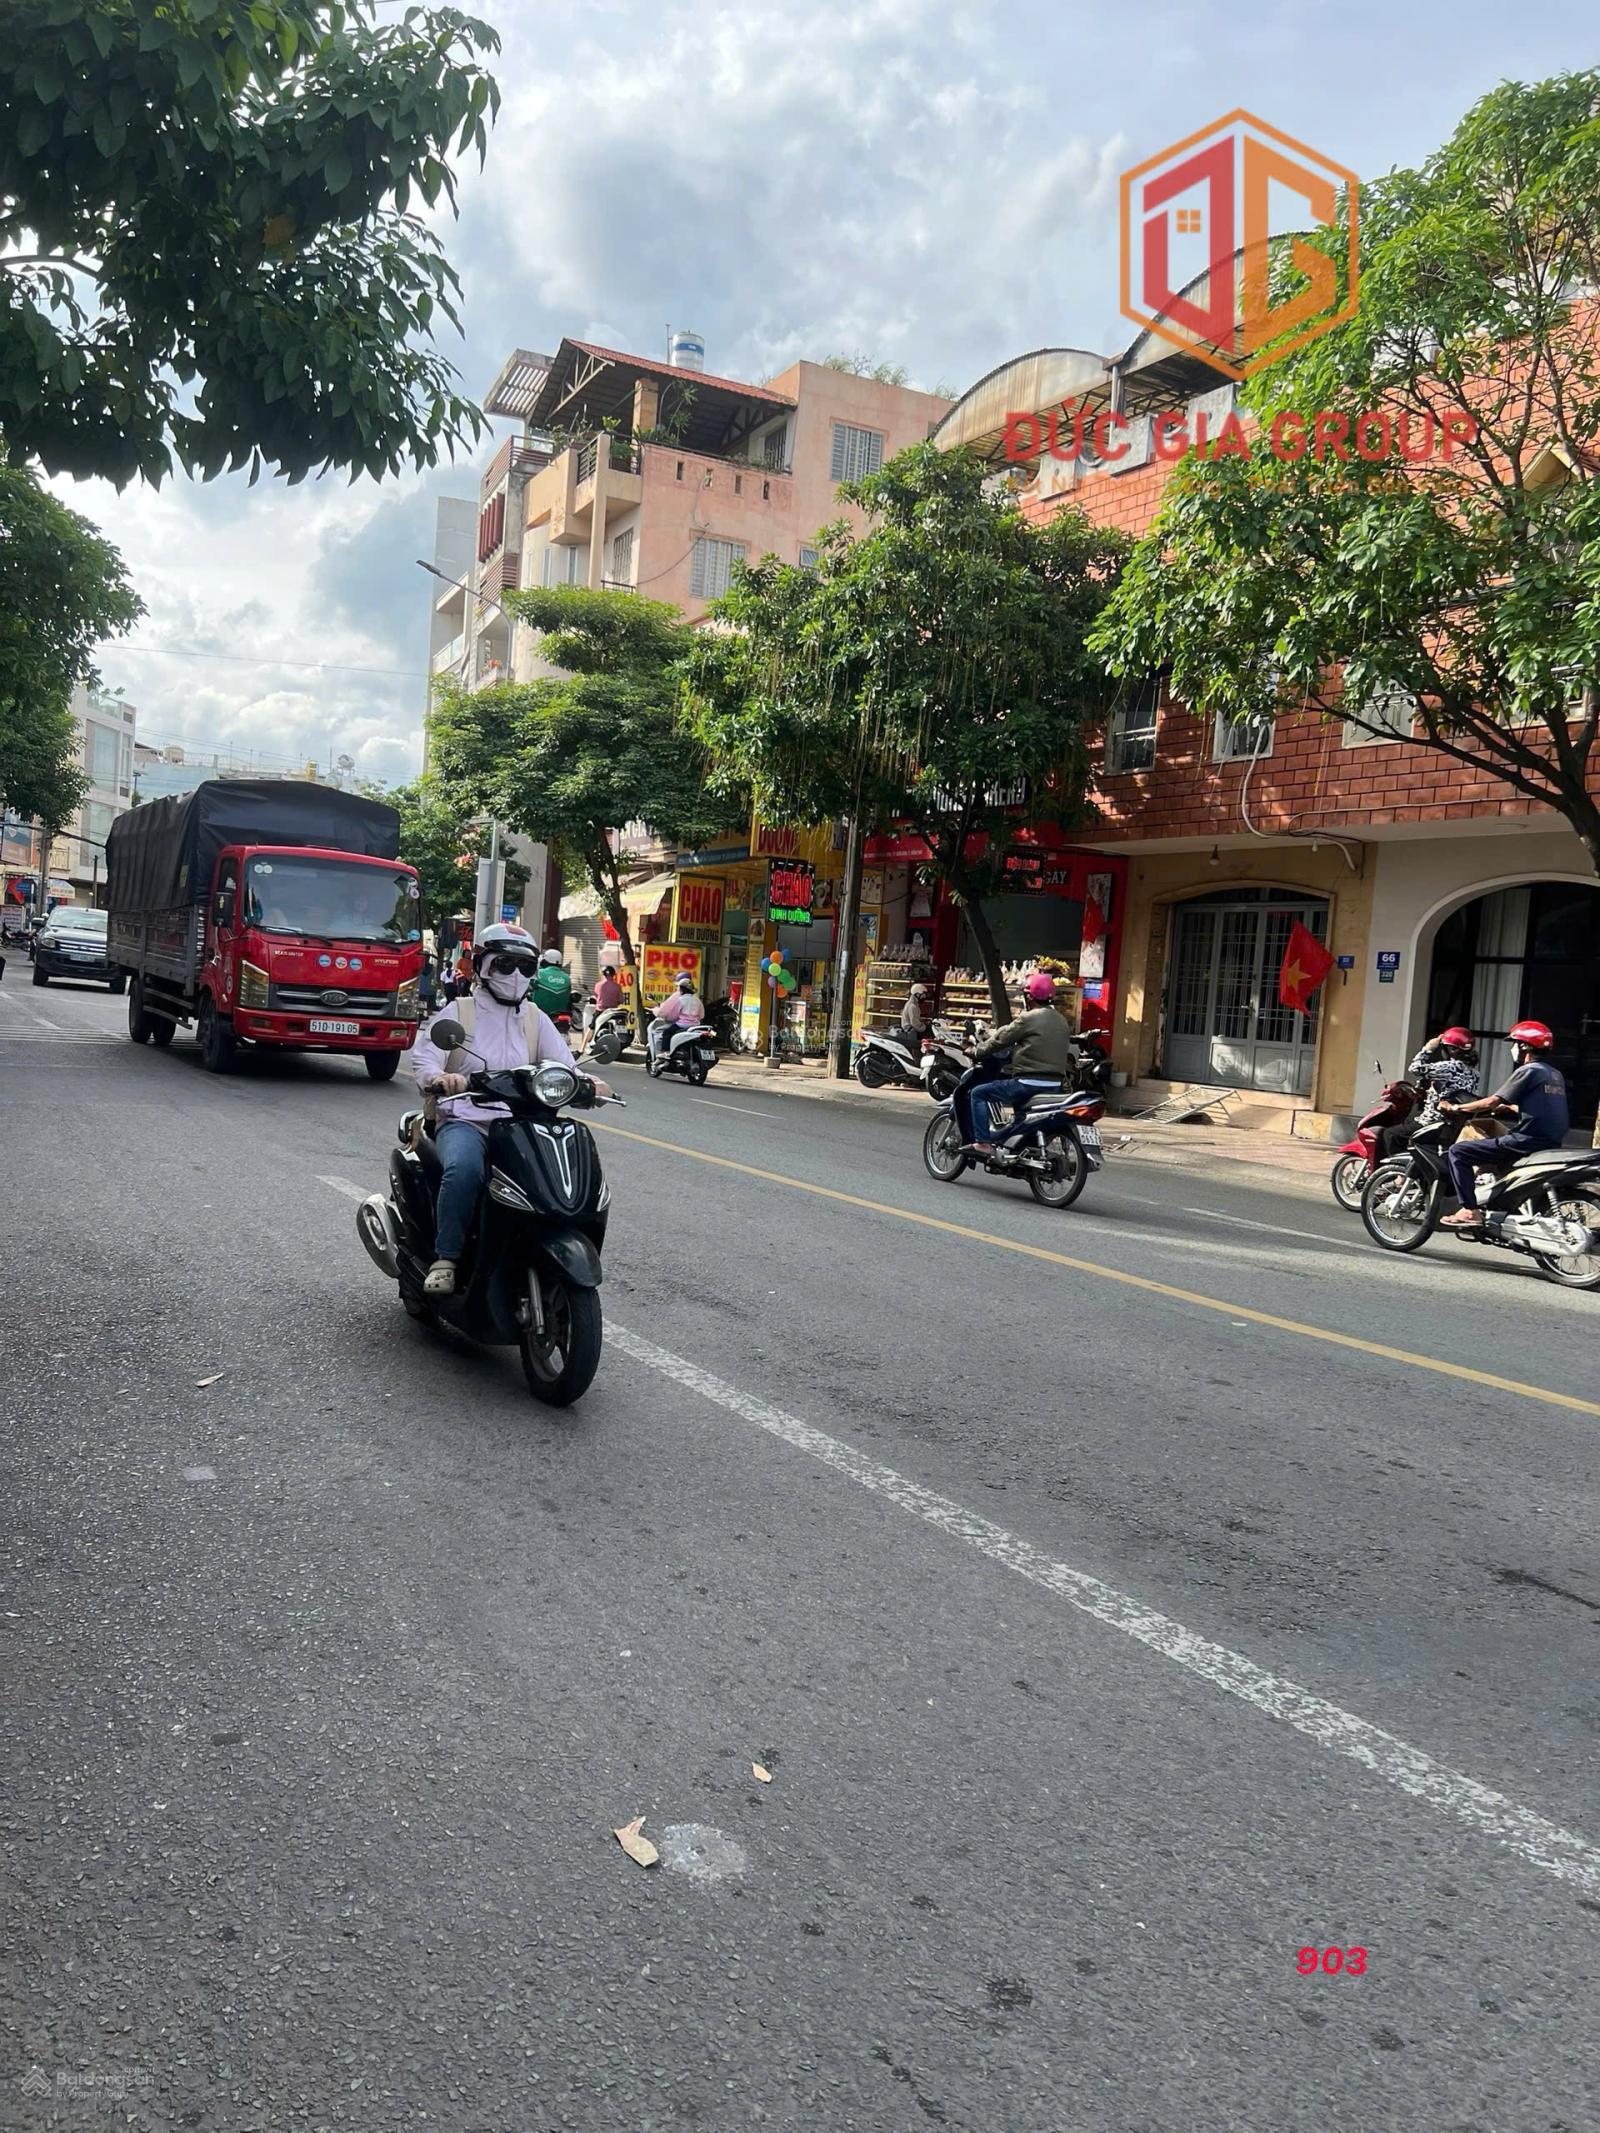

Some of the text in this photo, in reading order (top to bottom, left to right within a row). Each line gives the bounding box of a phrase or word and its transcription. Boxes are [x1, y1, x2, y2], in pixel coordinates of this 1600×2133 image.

[772, 864, 812, 909] CHÁO
[680, 881, 722, 925] CHÁO
[770, 909, 787, 921] DINH
[679, 927, 695, 941] DINH
[647, 948, 699, 970] PHỞ
[1382, 953, 1396, 963] 66
[547, 975, 565, 984] Grab
